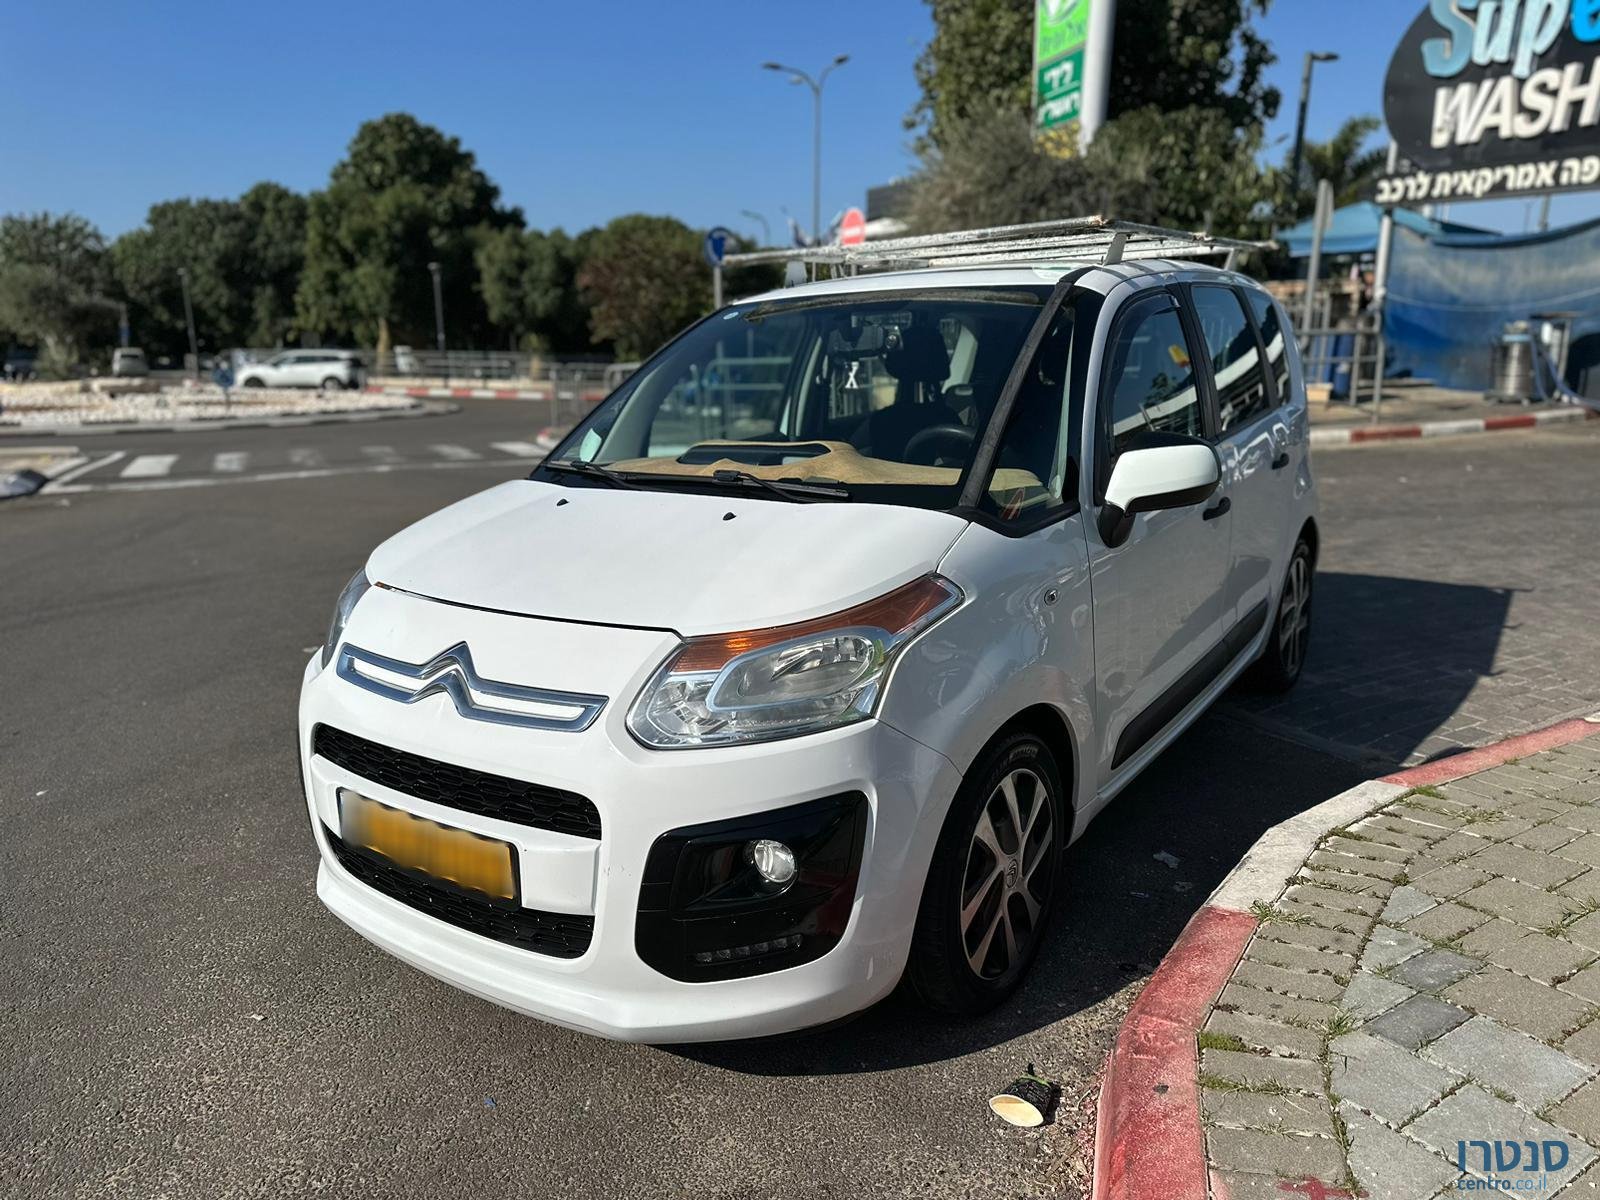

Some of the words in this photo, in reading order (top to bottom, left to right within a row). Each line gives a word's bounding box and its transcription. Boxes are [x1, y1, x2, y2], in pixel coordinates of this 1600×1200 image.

[1431, 56, 1600, 148] WASH
[1375, 170, 1433, 203] לרכב
[1431, 160, 1558, 198] אמריקאית
